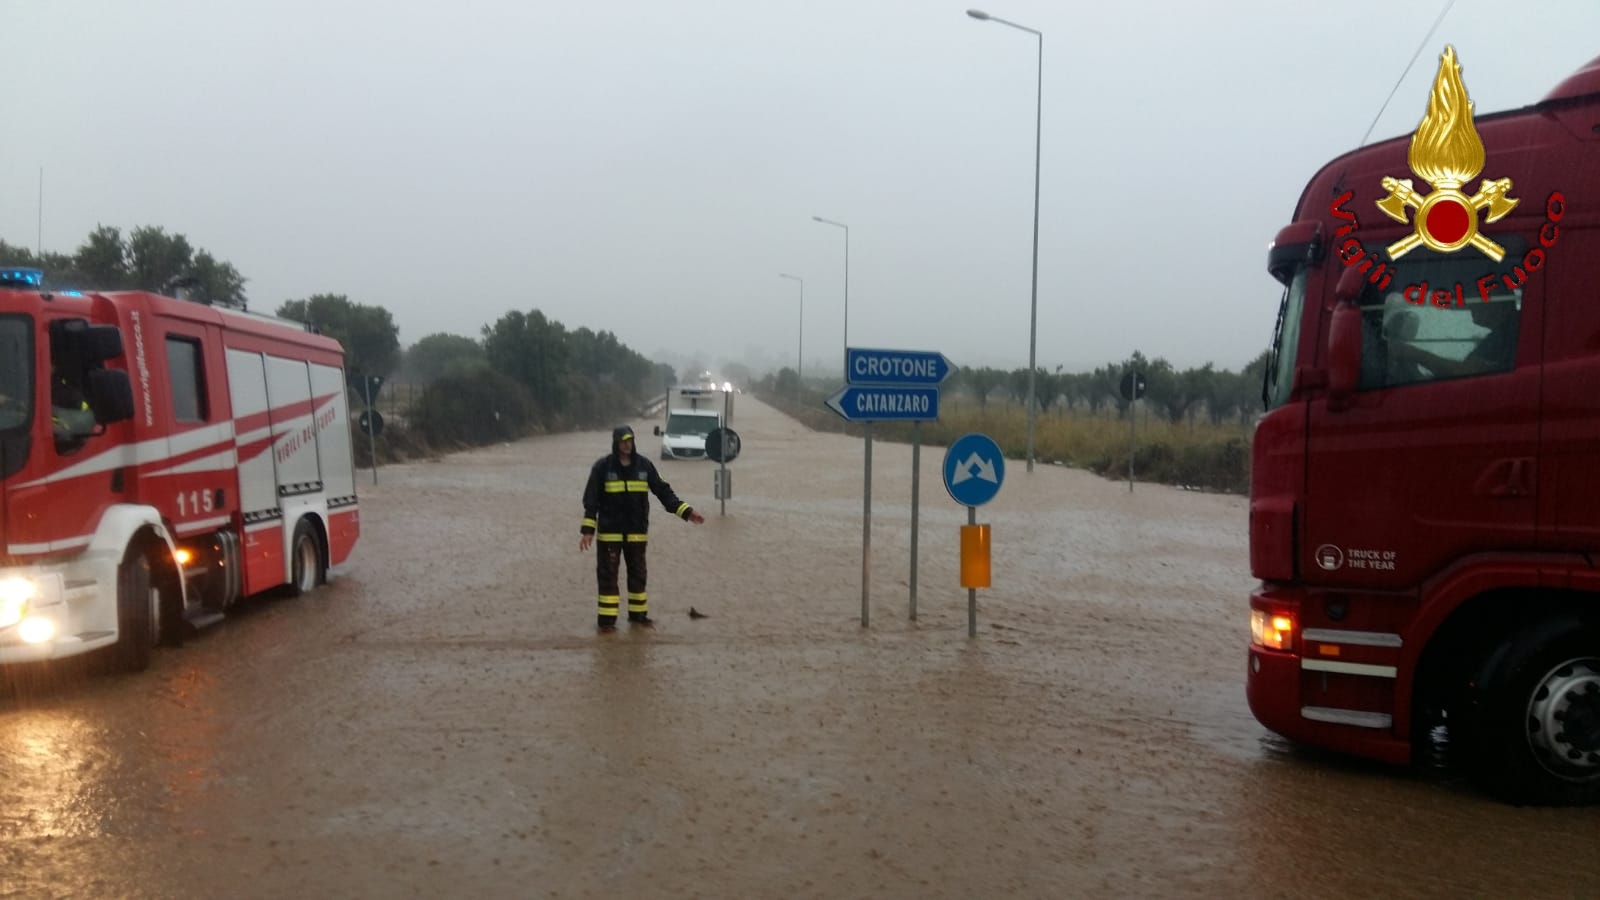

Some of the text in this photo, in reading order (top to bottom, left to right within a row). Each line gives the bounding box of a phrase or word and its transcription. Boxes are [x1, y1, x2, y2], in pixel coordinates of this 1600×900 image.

[855, 356, 937, 377] CROTONE
[856, 393, 929, 413] CATANZARO
[176, 488, 213, 517] 115
[1348, 549, 1396, 560] TRUCK OF
[1348, 559, 1396, 570] THE YEAR
